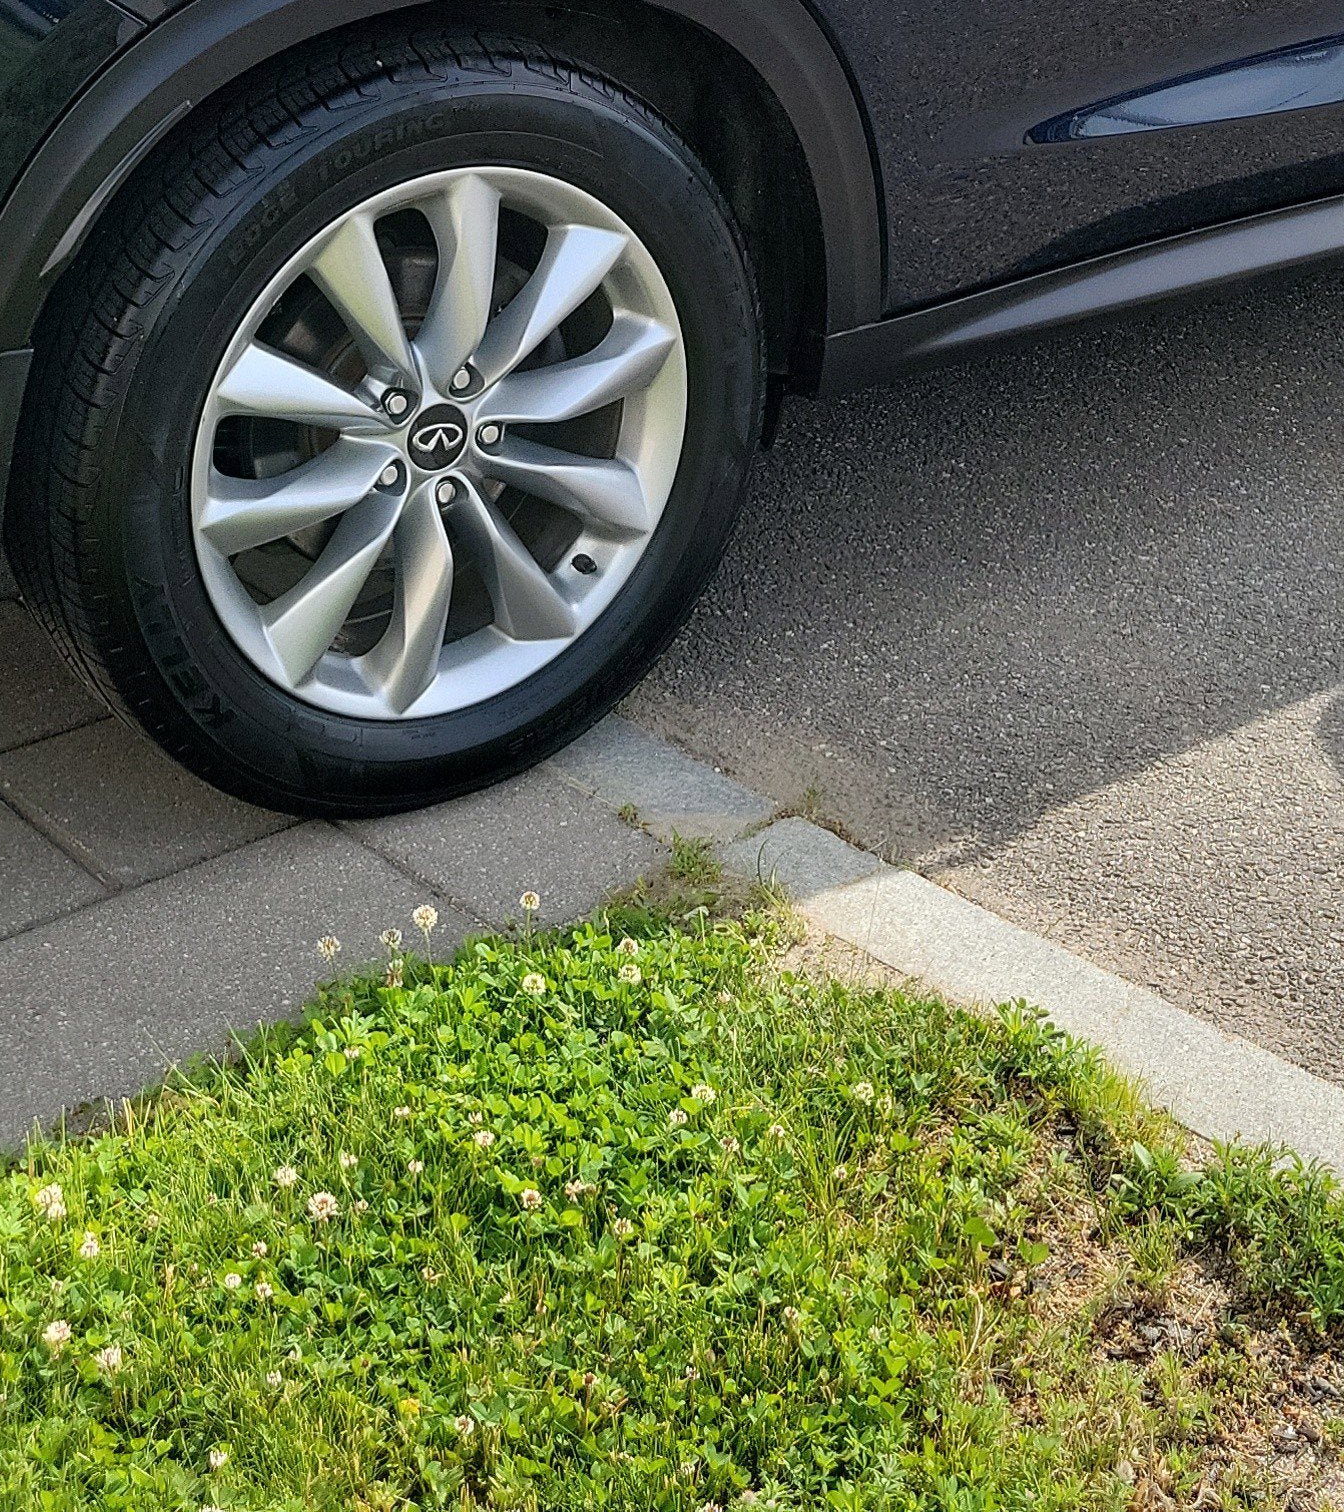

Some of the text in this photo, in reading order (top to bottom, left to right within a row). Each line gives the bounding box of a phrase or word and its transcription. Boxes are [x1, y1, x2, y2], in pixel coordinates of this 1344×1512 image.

[227, 178, 299, 266] EDGE
[316, 112, 446, 182] TOURING
[134, 578, 238, 730] KELLY
